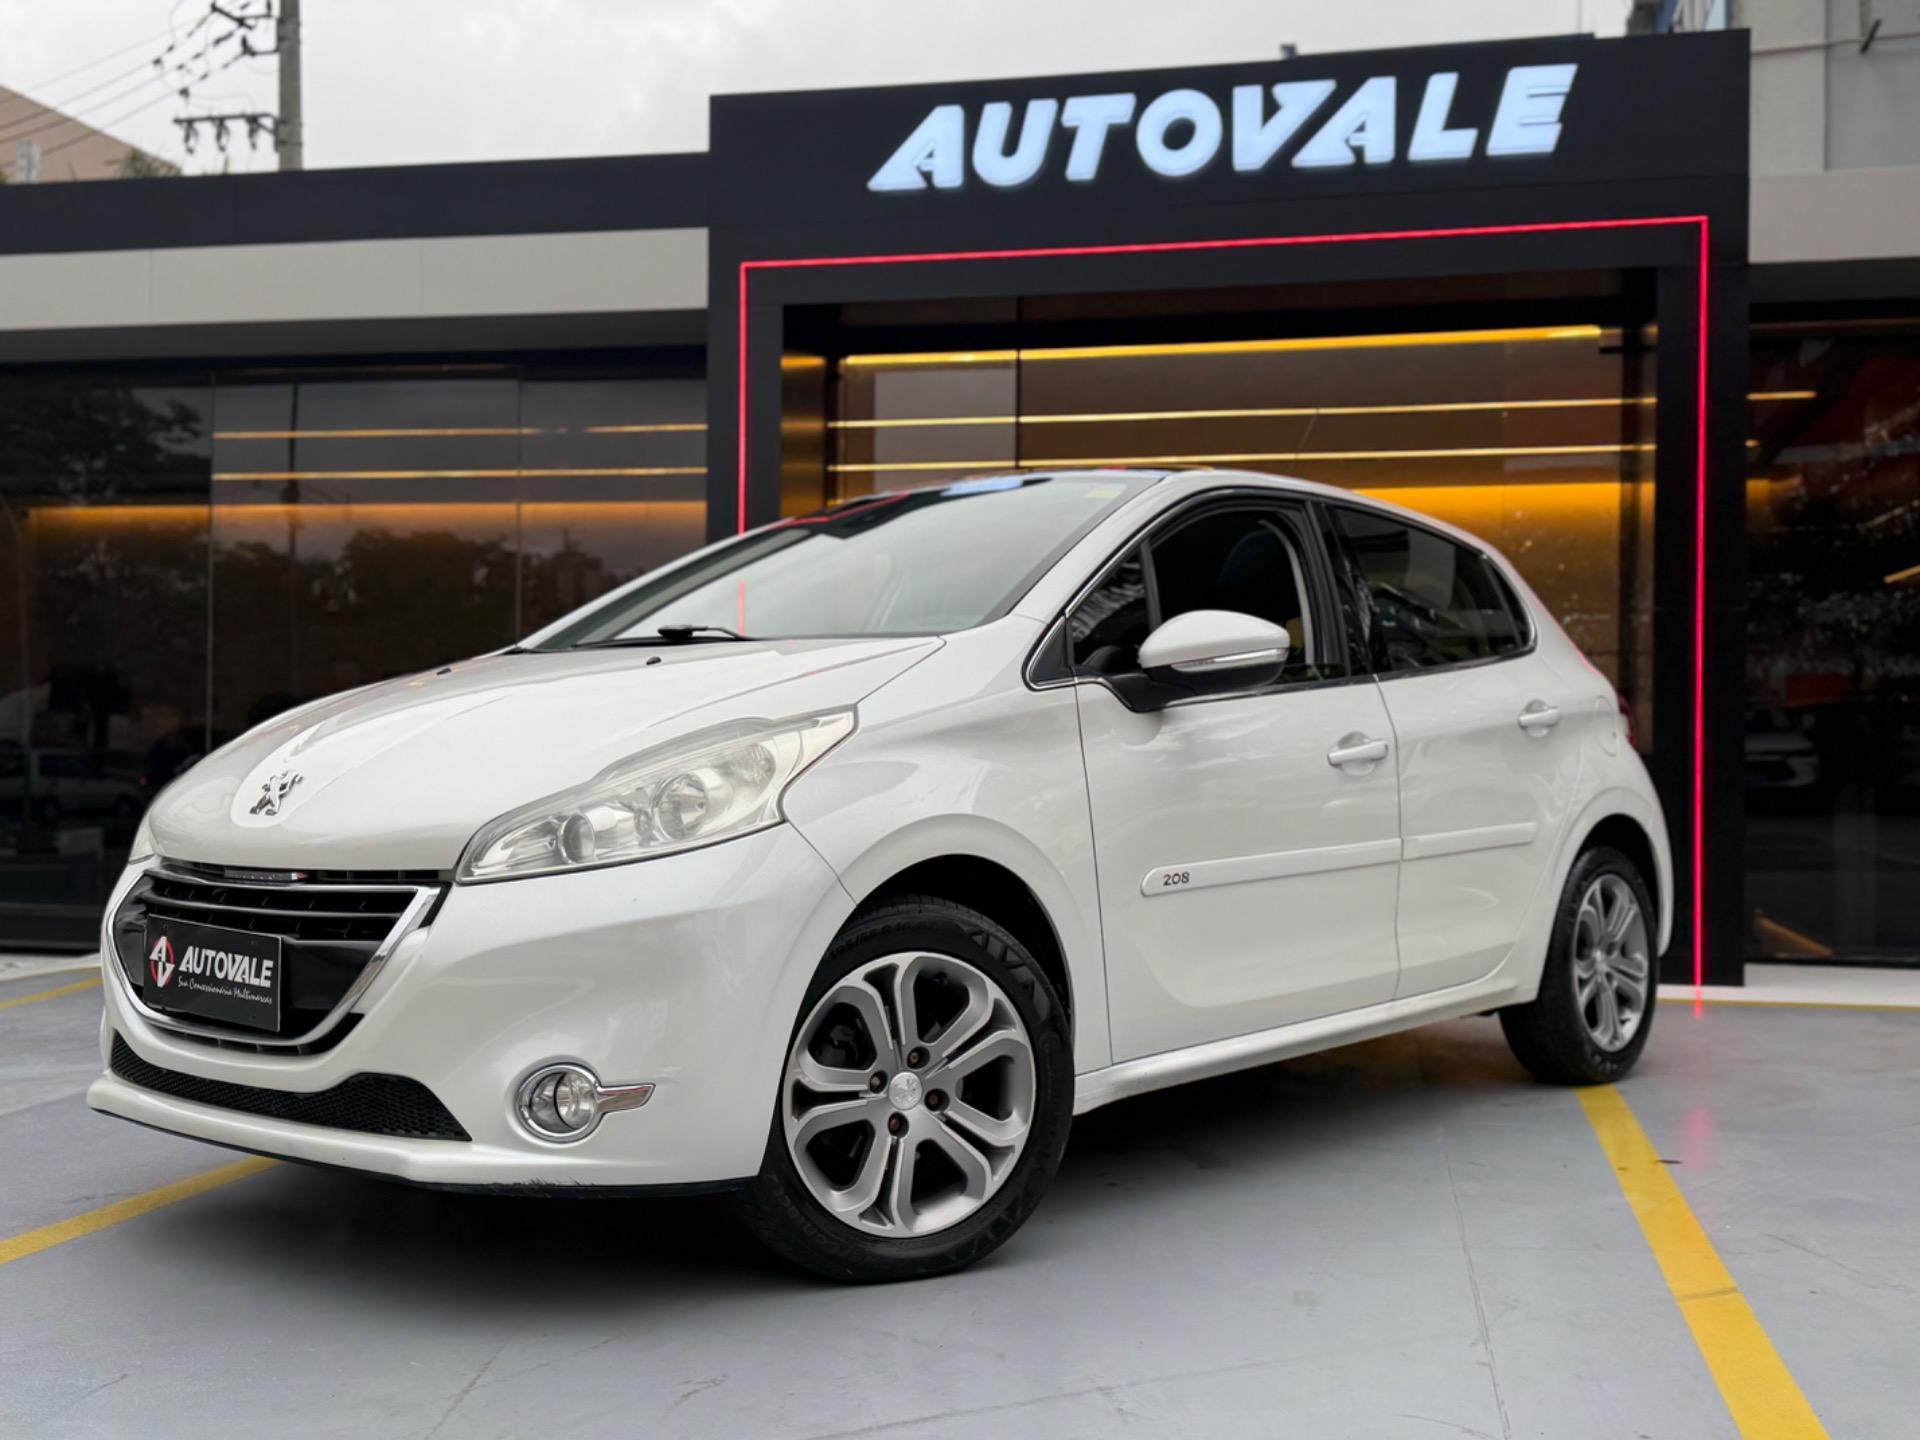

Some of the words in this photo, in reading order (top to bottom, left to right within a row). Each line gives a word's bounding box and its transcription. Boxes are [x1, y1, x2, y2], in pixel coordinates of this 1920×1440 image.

[867, 62, 1579, 191] AUTOVALE
[1163, 871, 1190, 886] 208
[178, 945, 273, 988] AUTOVALE
